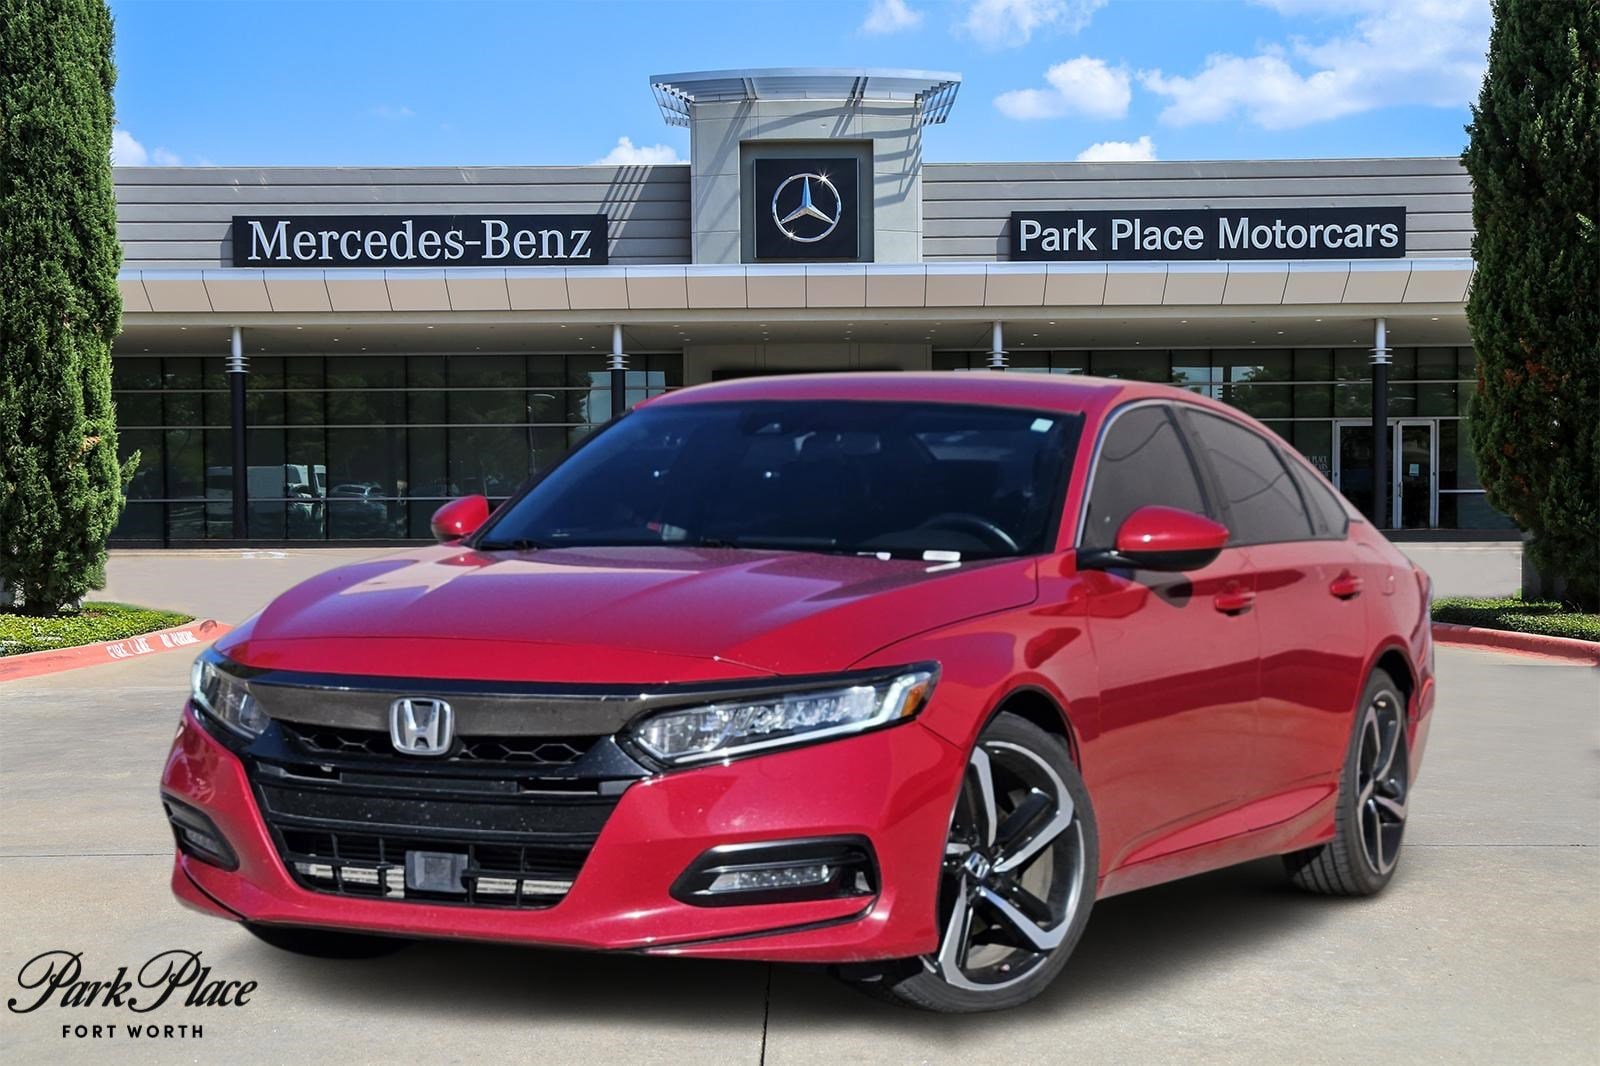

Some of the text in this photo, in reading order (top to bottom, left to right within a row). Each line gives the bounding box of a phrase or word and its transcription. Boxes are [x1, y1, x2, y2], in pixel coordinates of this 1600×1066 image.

[247, 219, 592, 260] Mercedes-Benz
[1019, 217, 1399, 252] Park Place Motorcars
